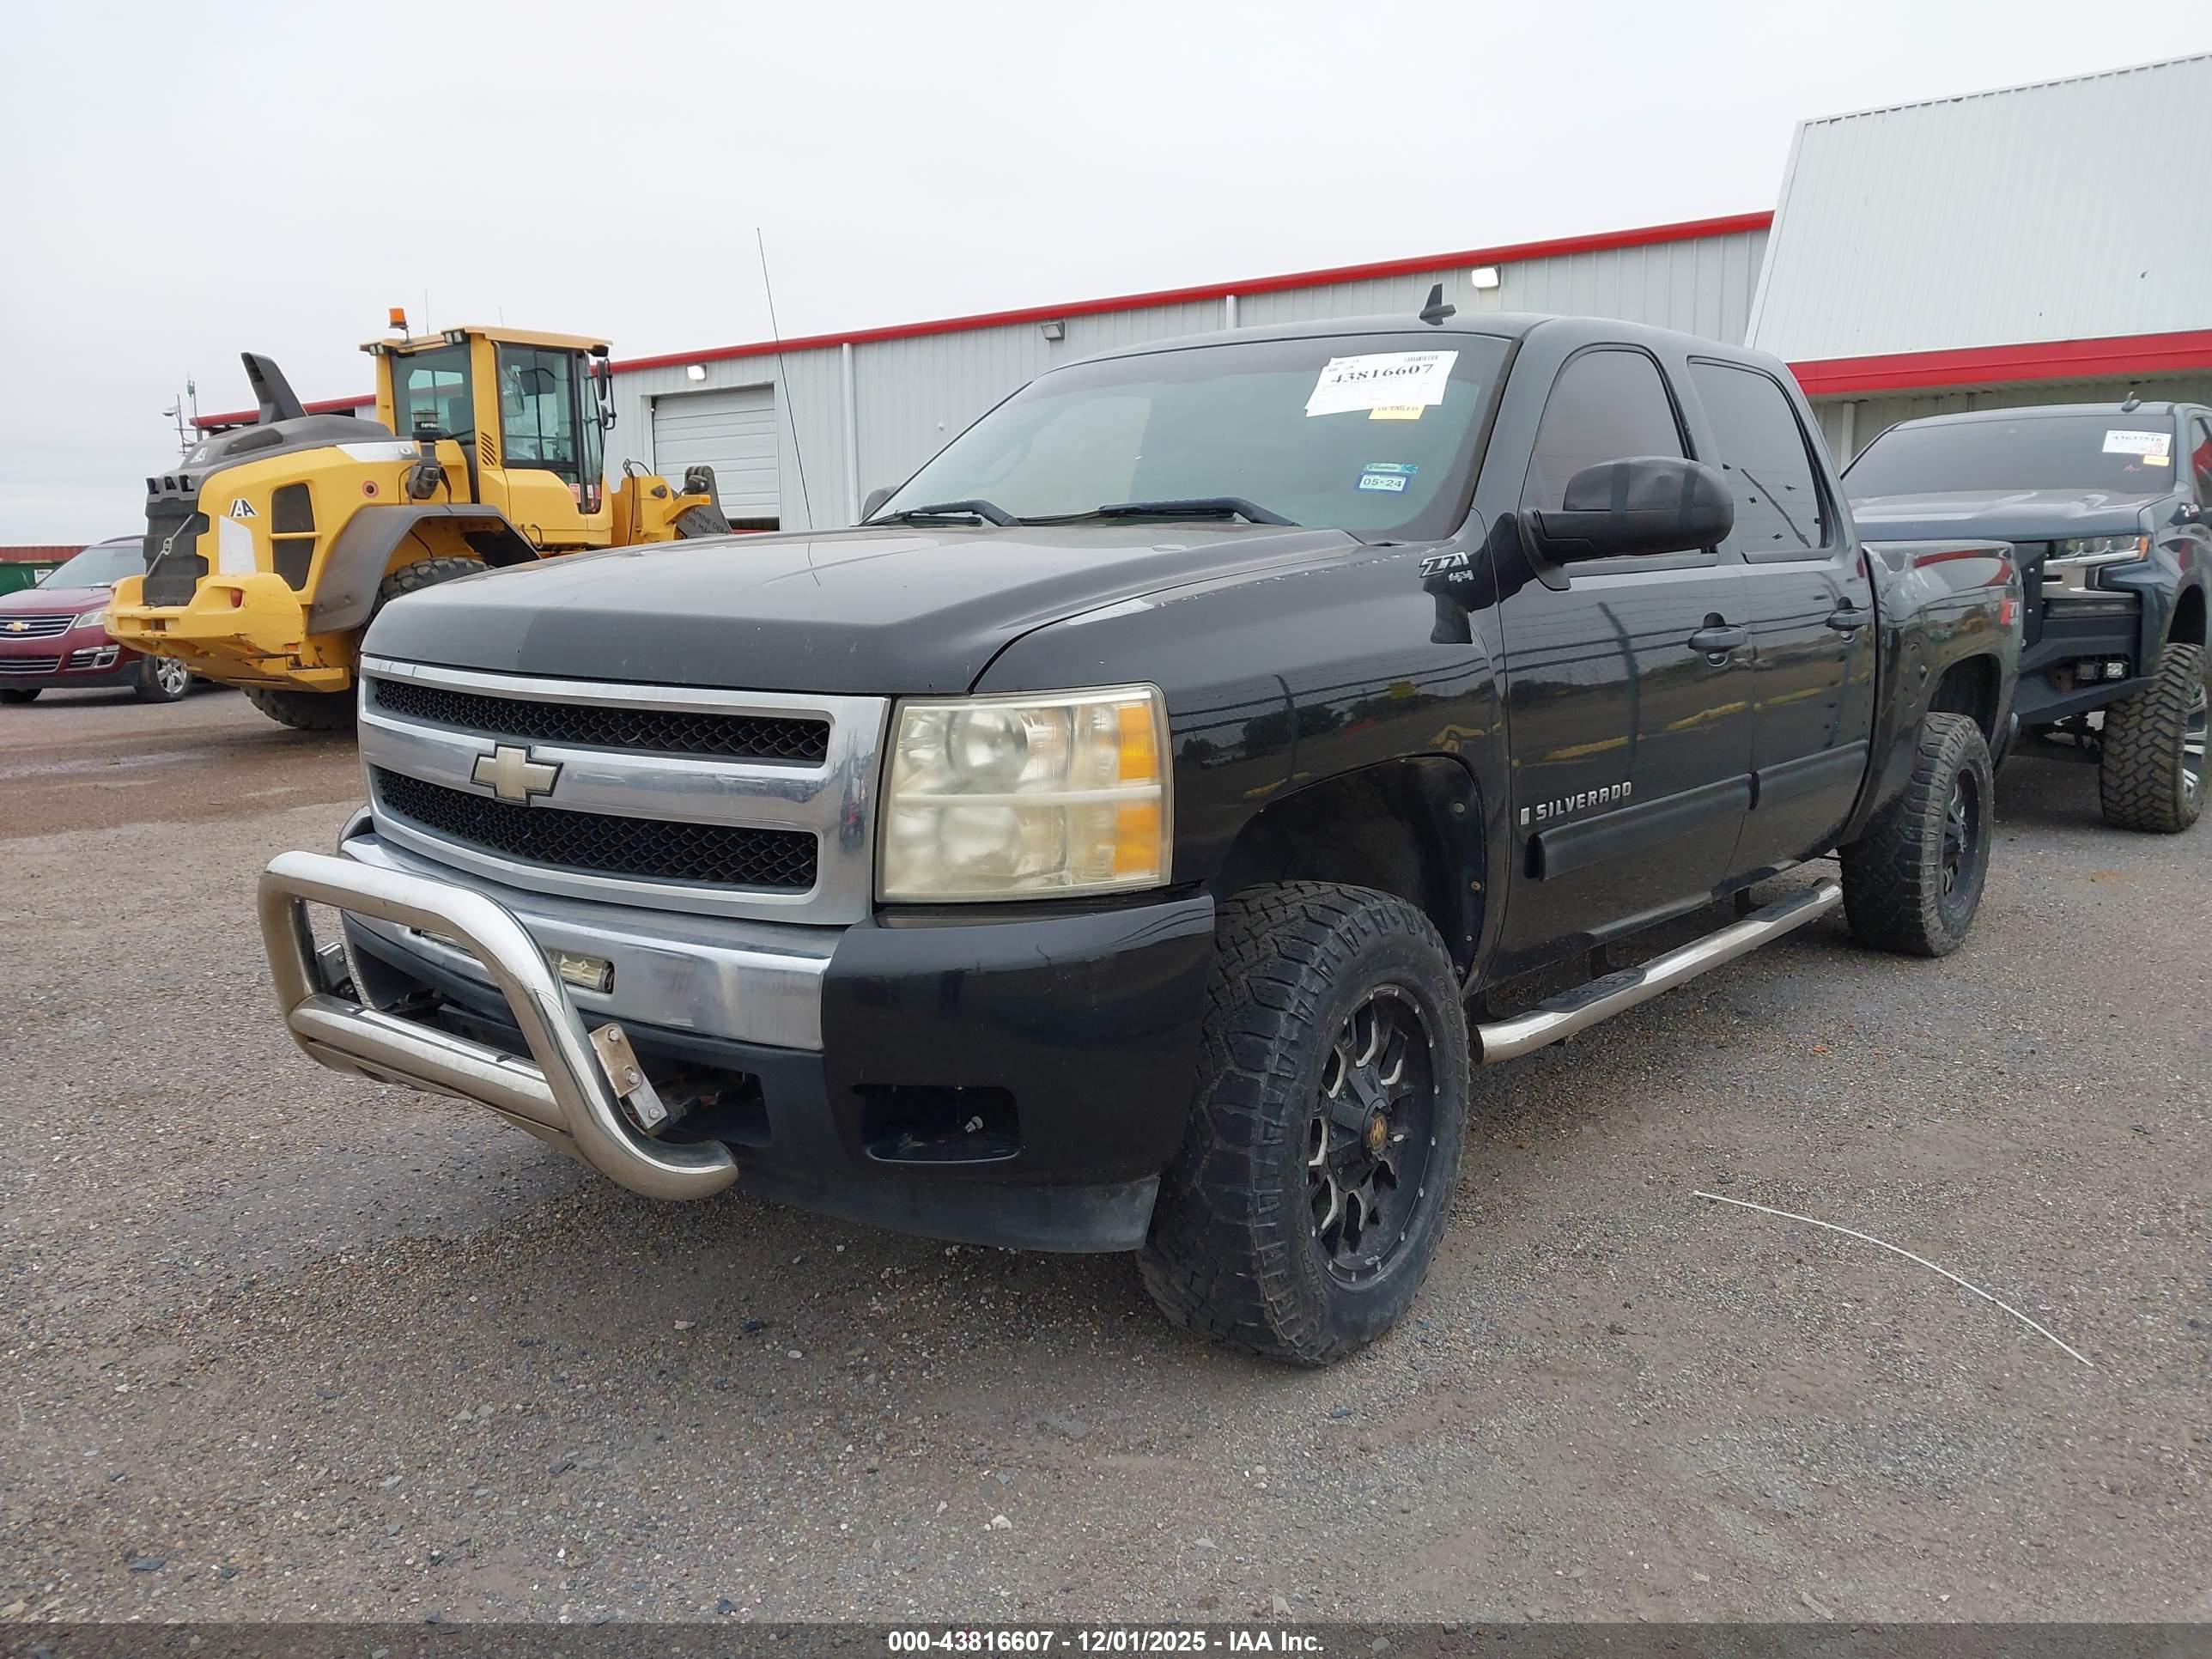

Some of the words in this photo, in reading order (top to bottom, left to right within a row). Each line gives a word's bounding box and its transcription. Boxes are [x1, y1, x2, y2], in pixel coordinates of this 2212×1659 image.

[1331, 364, 1434, 384] 43816607
[1419, 551, 1469, 577] Z71
[1535, 781, 1632, 821] SILVERADO
